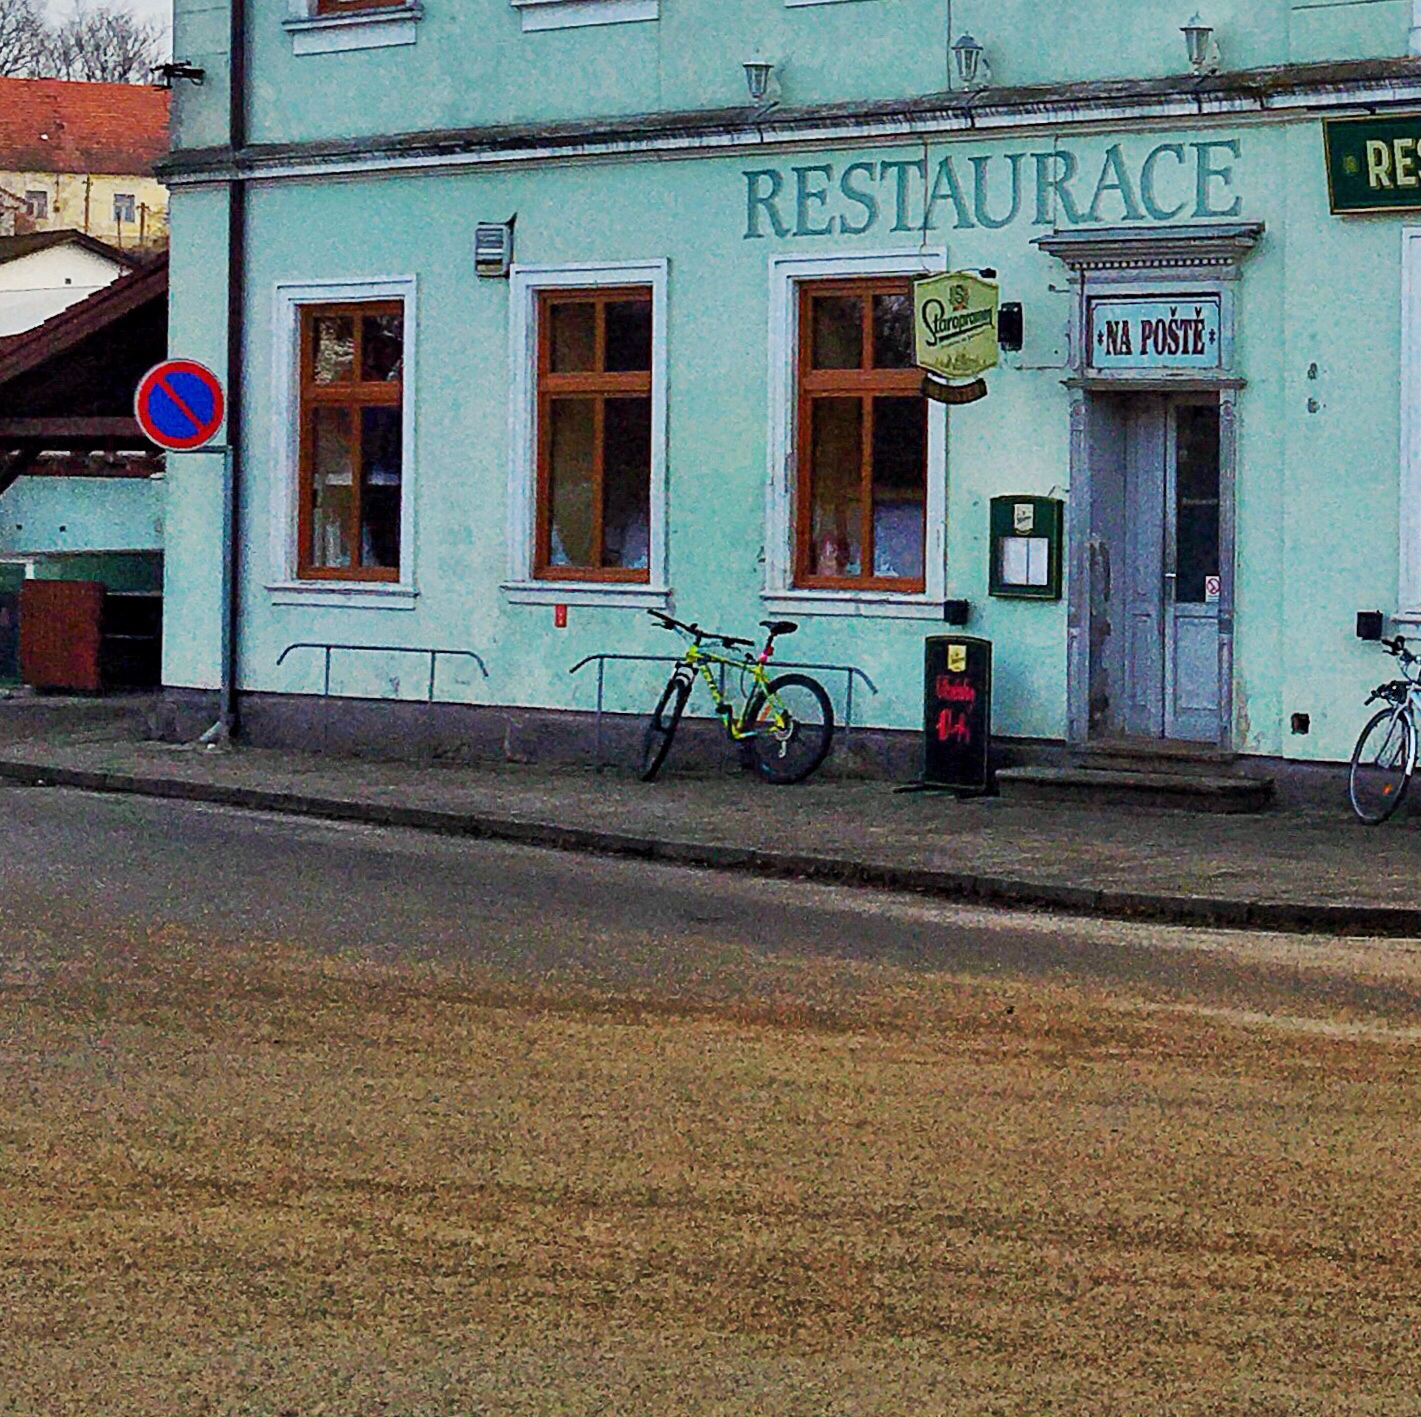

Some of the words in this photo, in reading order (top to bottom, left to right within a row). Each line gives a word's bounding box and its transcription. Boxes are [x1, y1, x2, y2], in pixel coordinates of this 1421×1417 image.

[742, 138, 1243, 239] RESTAURACE
[1105, 319, 1133, 356] NA
[1140, 306, 1205, 356] POŠTĚ
